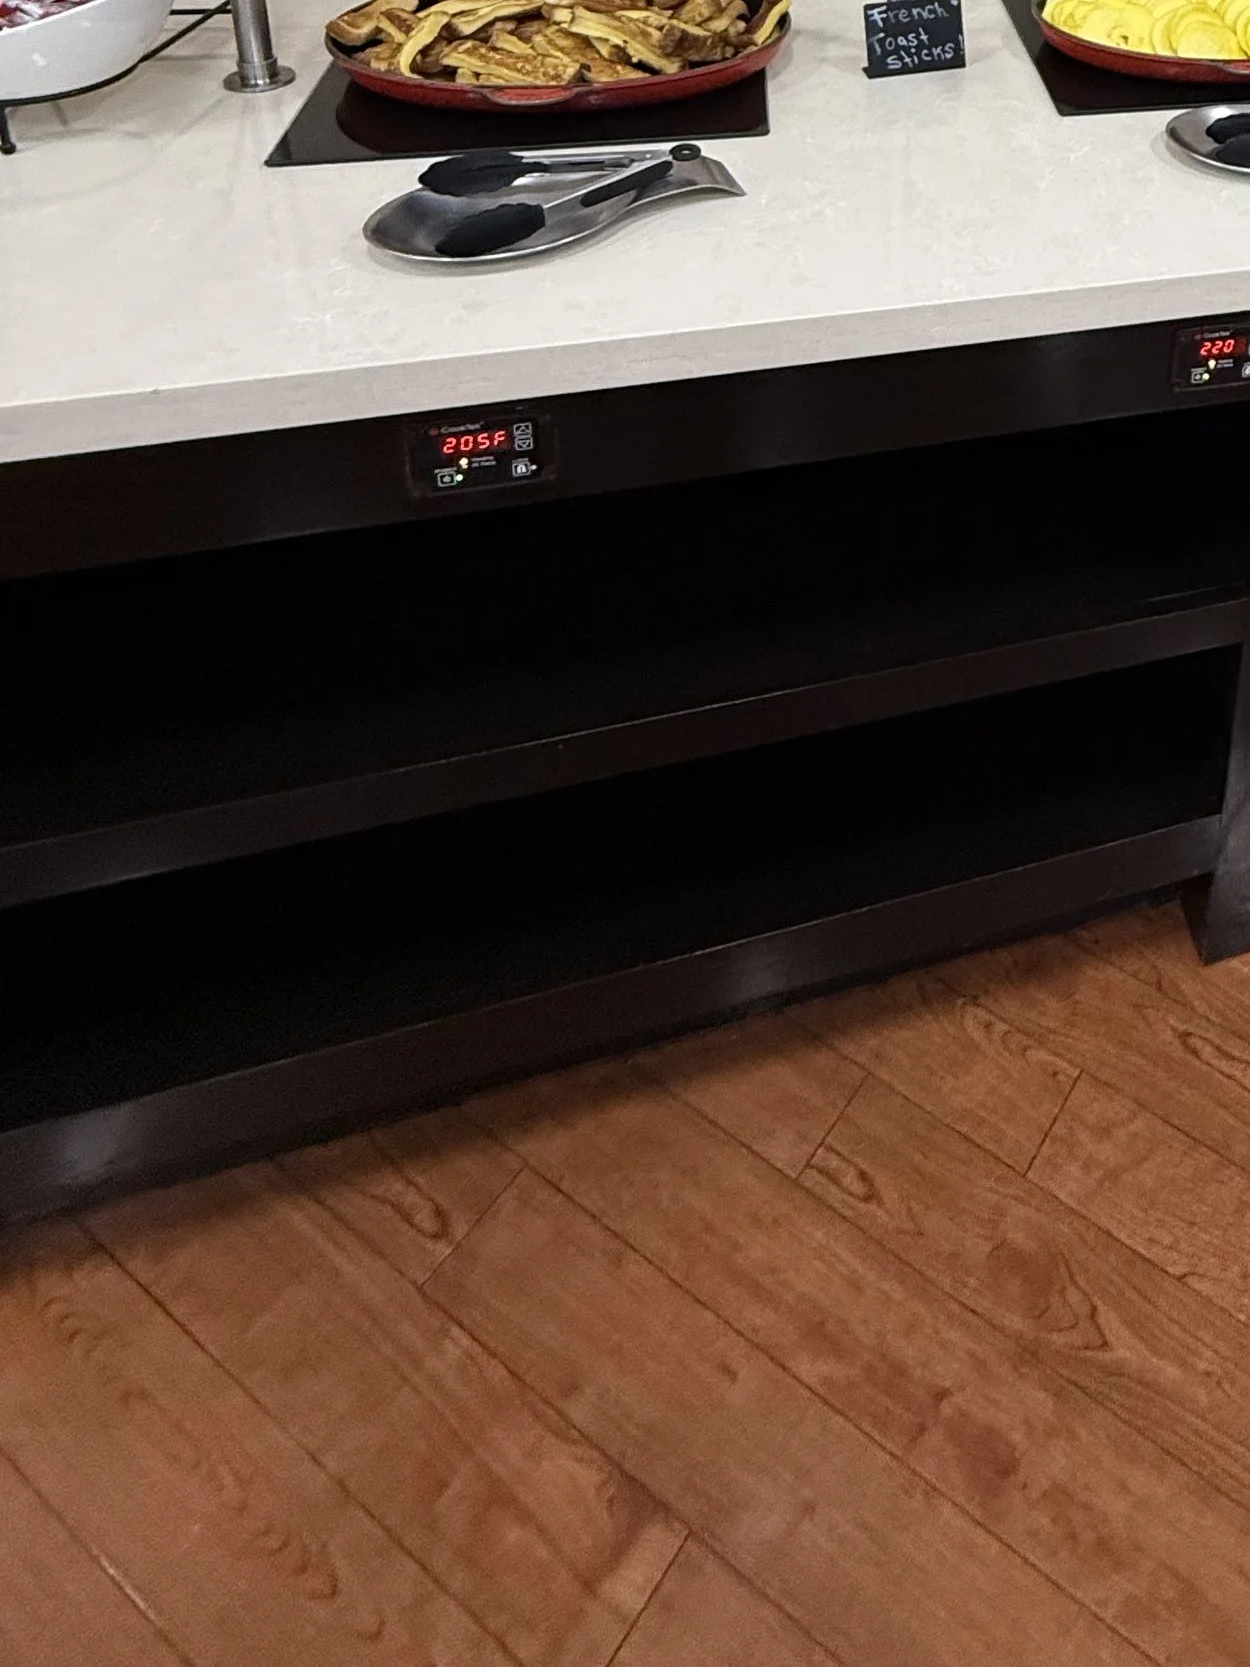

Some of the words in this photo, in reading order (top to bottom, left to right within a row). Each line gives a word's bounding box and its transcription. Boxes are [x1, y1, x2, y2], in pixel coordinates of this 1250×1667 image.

[867, 2, 950, 27] French
[868, 27, 929, 56] Toast
[1200, 339, 1235, 355] 220
[443, 431, 506, 453] 205F
